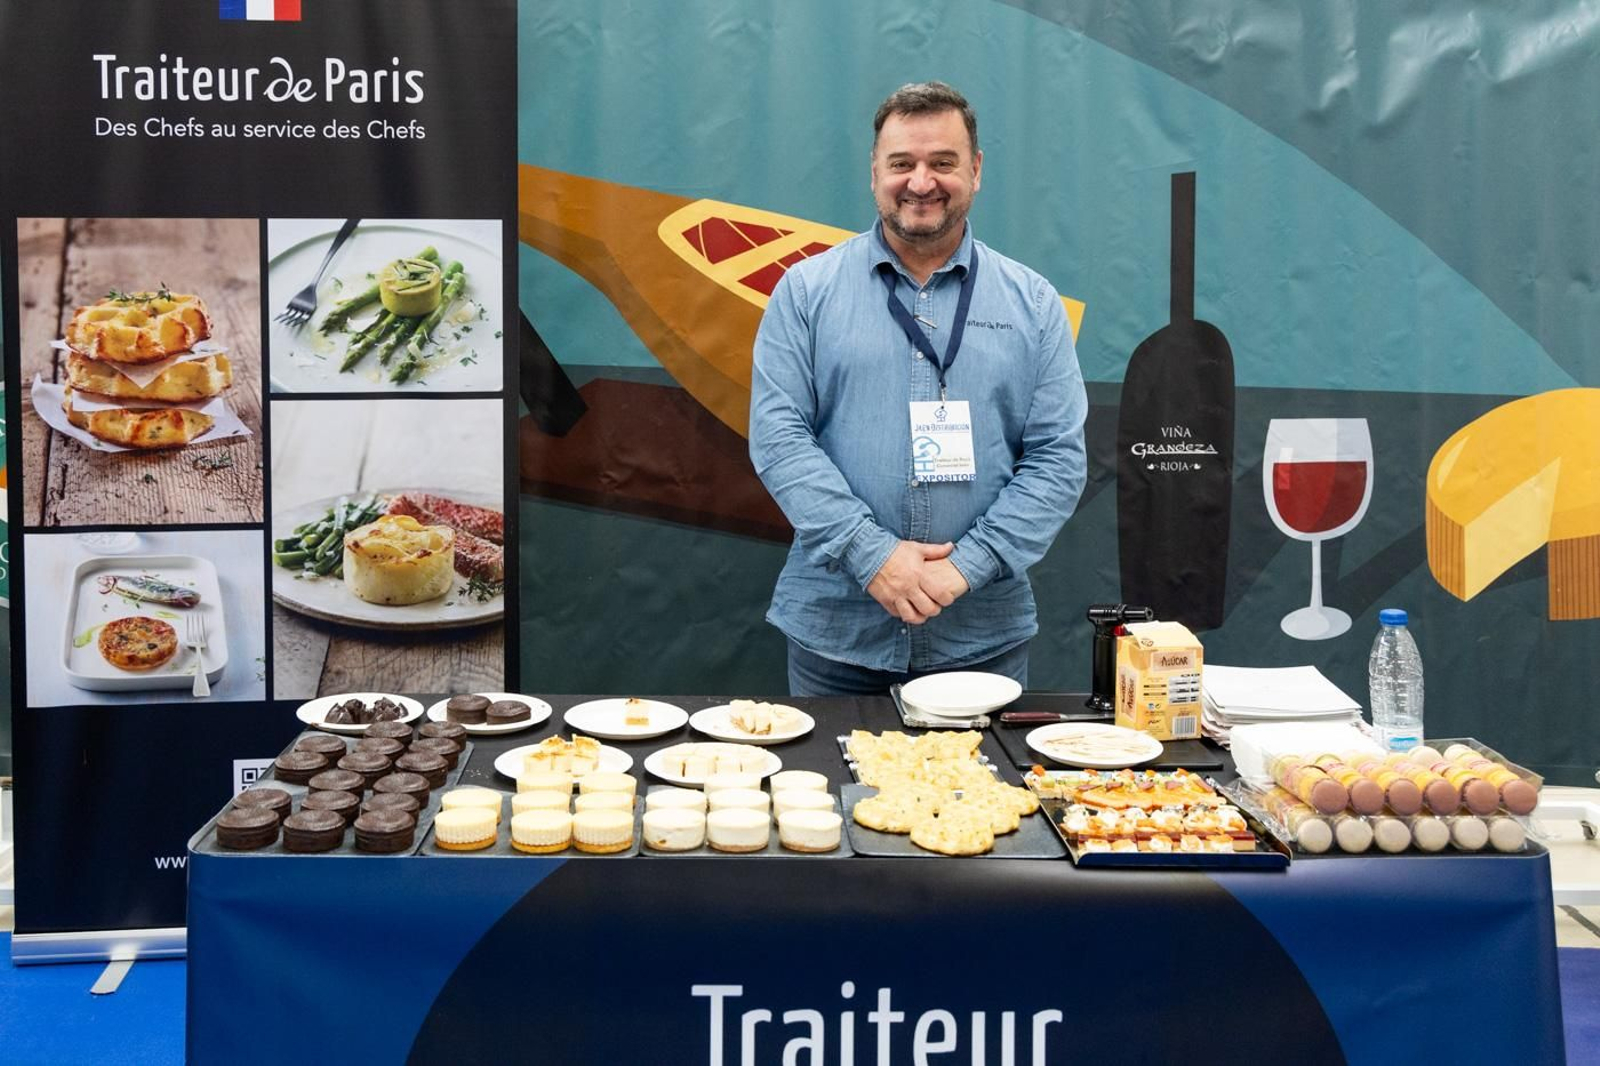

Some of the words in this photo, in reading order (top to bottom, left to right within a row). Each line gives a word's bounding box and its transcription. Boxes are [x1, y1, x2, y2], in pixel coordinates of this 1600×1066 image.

[93, 53, 260, 102] Traiteur
[262, 56, 317, 104] de
[325, 56, 425, 104] Paris
[95, 117, 138, 137] Des
[143, 116, 205, 138] Chefs
[210, 123, 236, 138] au
[243, 119, 316, 139] service
[322, 119, 361, 139] des
[366, 119, 426, 140] Chefs
[1160, 424, 1192, 438] VIÑA
[1160, 461, 1190, 472] RIOJA
[915, 473, 977, 483] EXPOSITOR
[691, 981, 1063, 1066] Traiteur
